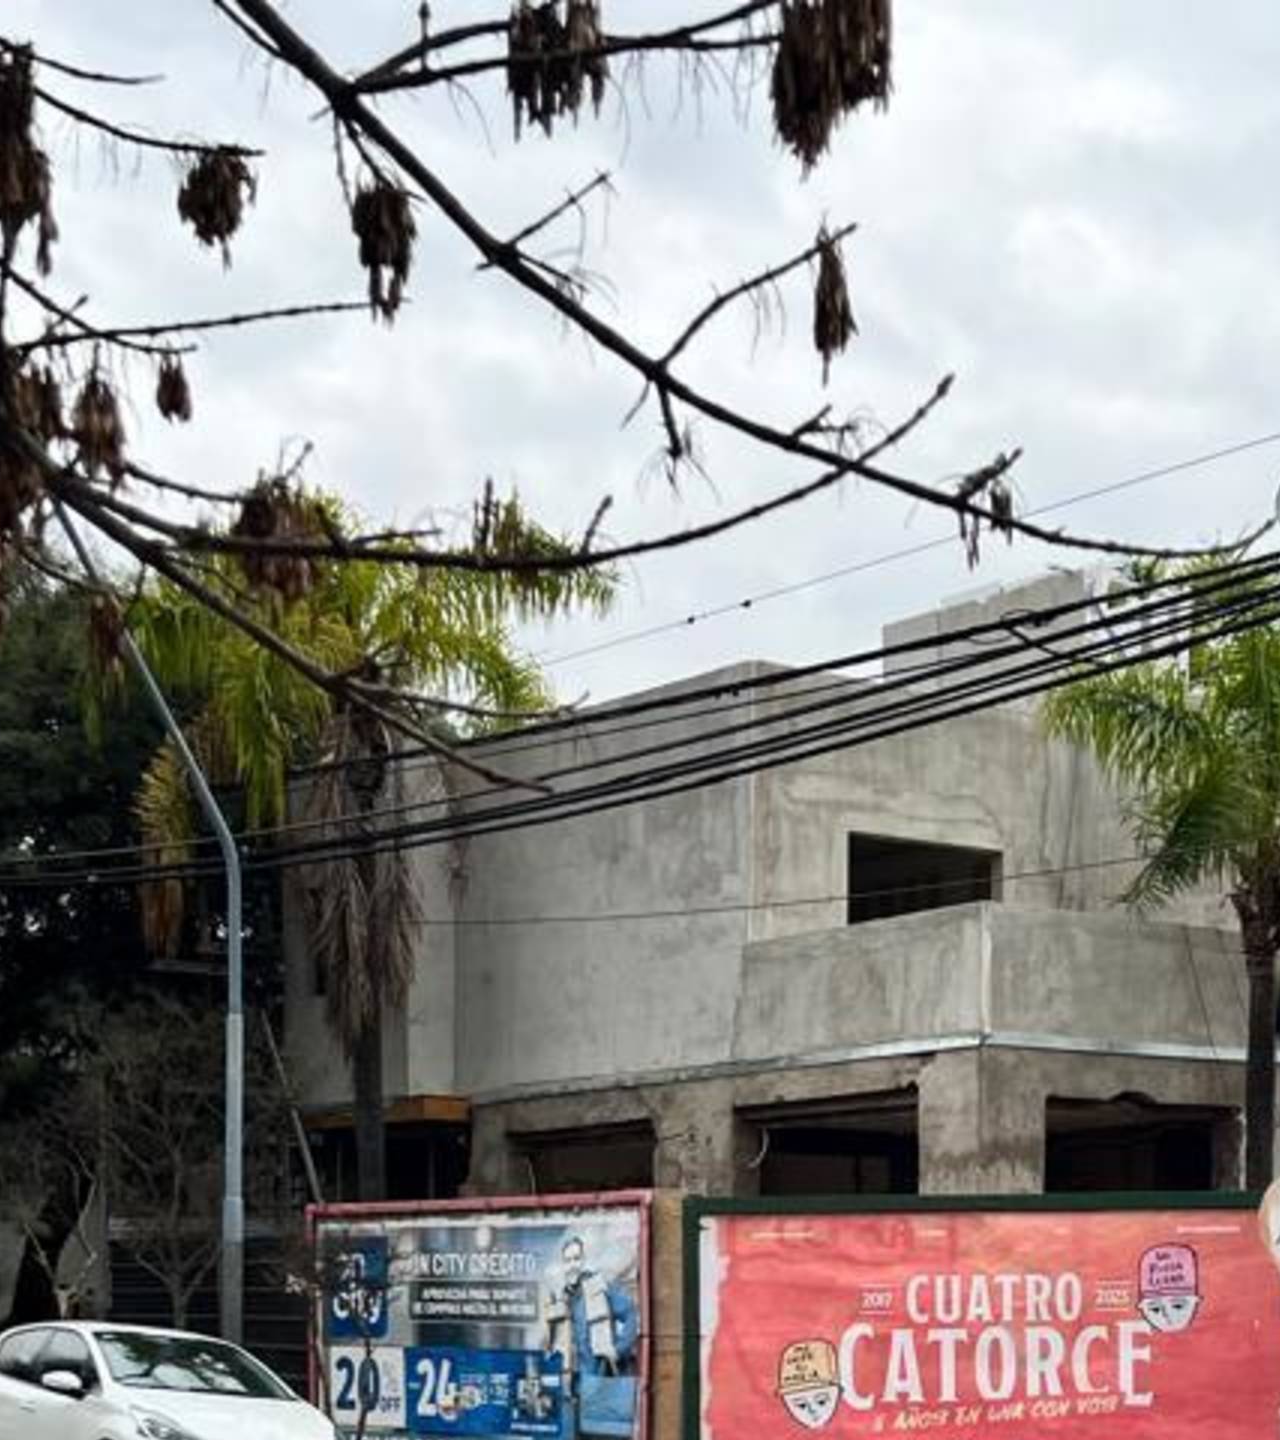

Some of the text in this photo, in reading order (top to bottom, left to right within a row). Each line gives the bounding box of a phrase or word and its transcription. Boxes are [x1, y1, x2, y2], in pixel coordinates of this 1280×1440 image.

[432, 1253, 468, 1276] CITY
[906, 1272, 1083, 1324] CUATRO
[839, 1319, 1154, 1411] CATORCE
